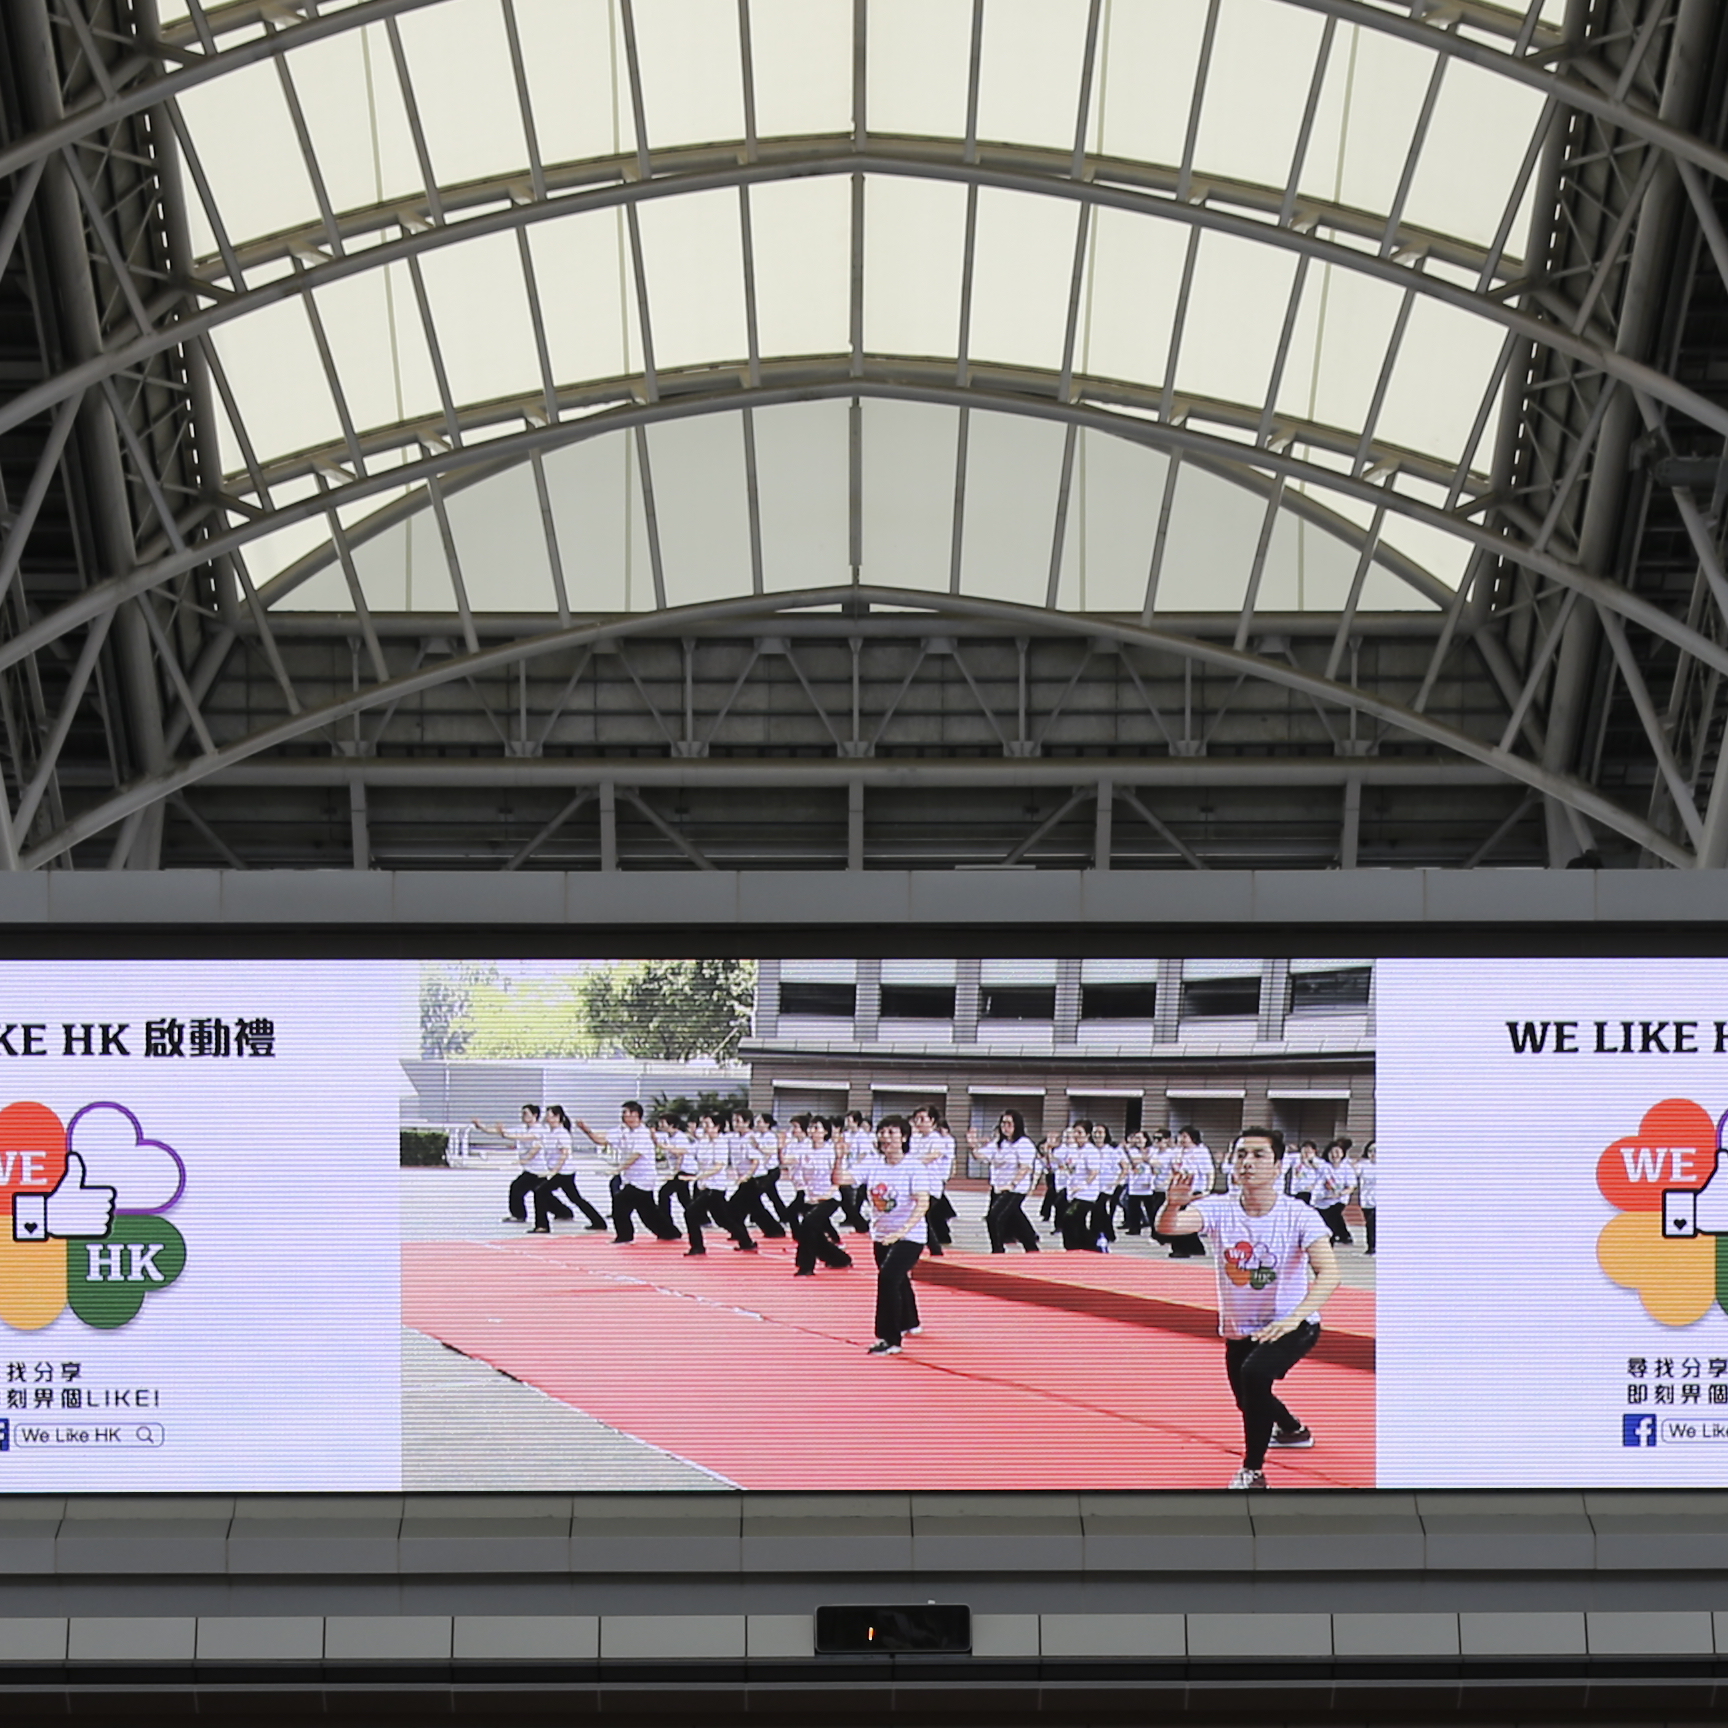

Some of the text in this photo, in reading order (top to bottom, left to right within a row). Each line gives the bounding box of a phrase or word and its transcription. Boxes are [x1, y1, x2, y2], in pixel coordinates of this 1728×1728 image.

[62, 1024, 131, 1056] HK
[1505, 1021, 1579, 1054] WE
[1593, 1021, 1698, 1053] LIKE
[1619, 1147, 1698, 1183] WE
[85, 1243, 165, 1281] HK
[1627, 1357, 1728, 1378] 尋找分享
[21, 1428, 50, 1443] We
[55, 1428, 90, 1443] Like
[94, 1428, 121, 1442] HK
[1668, 1424, 1696, 1439] We
